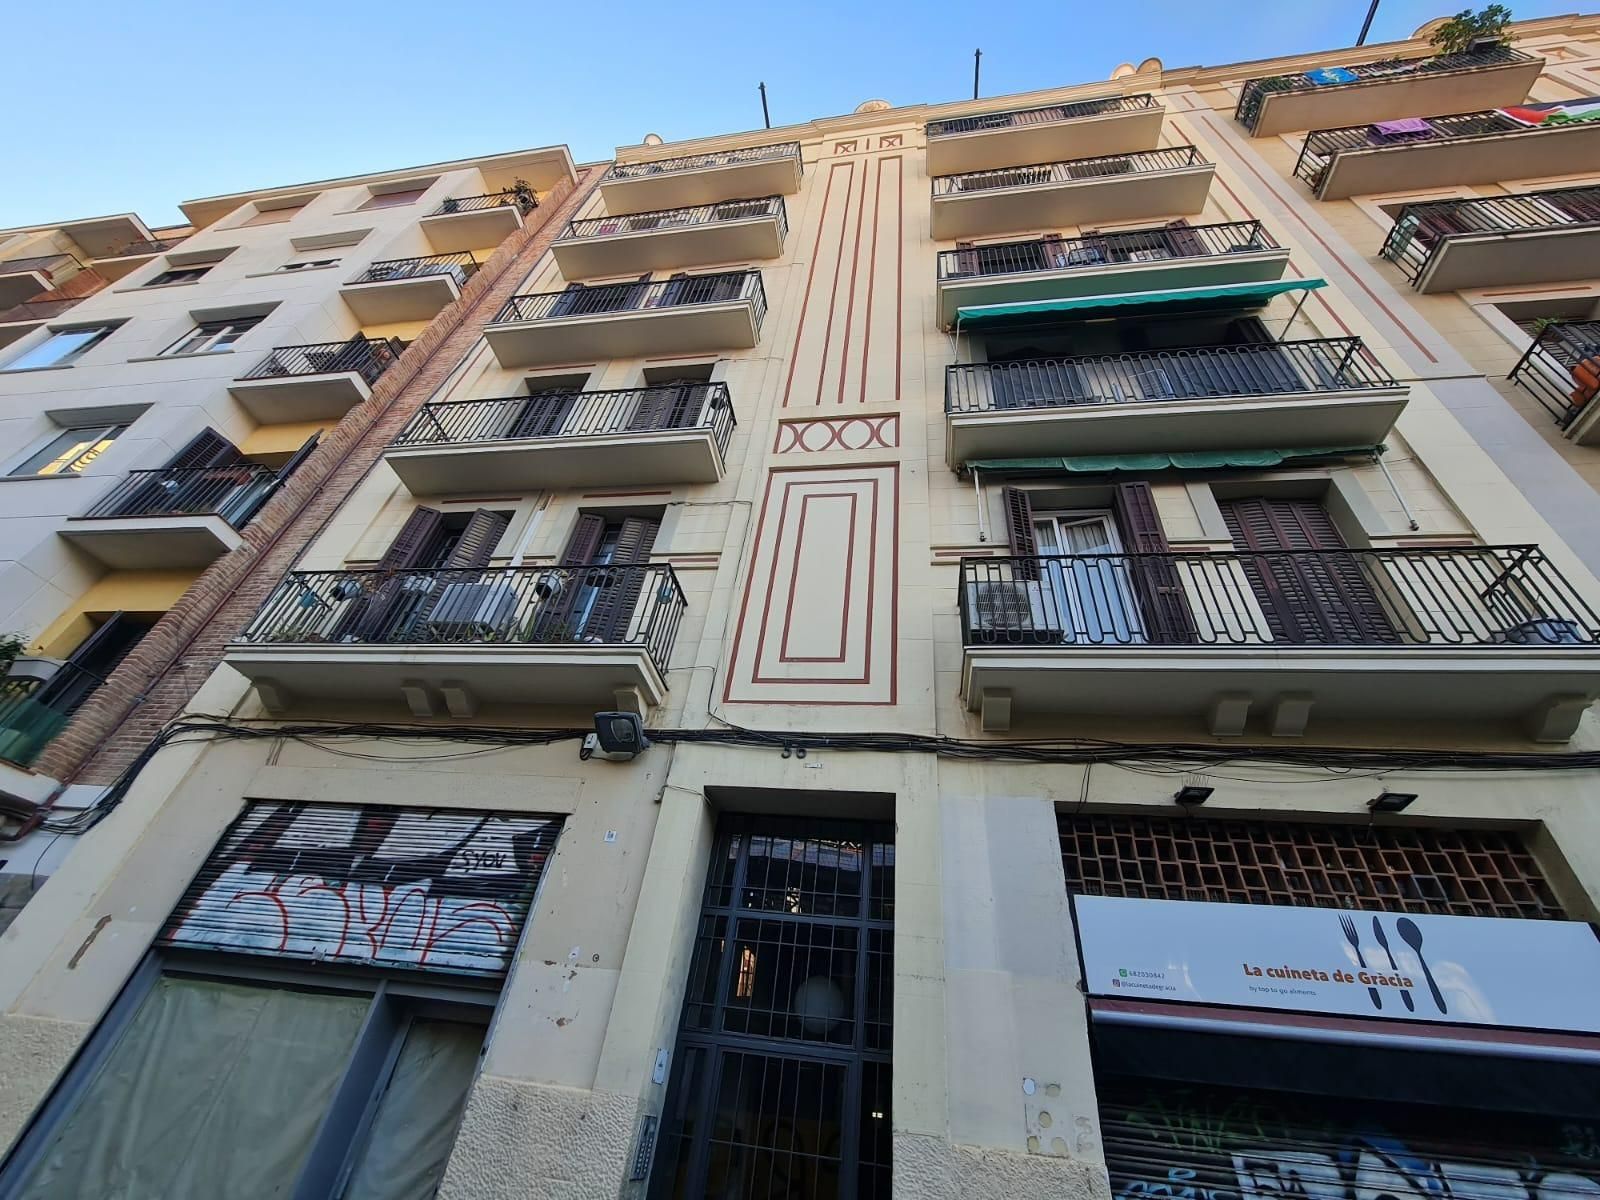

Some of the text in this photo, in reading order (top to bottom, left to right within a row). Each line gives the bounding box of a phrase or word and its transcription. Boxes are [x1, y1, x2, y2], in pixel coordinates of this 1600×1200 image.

[1243, 963, 1414, 988] La cuineta de Gràcia
